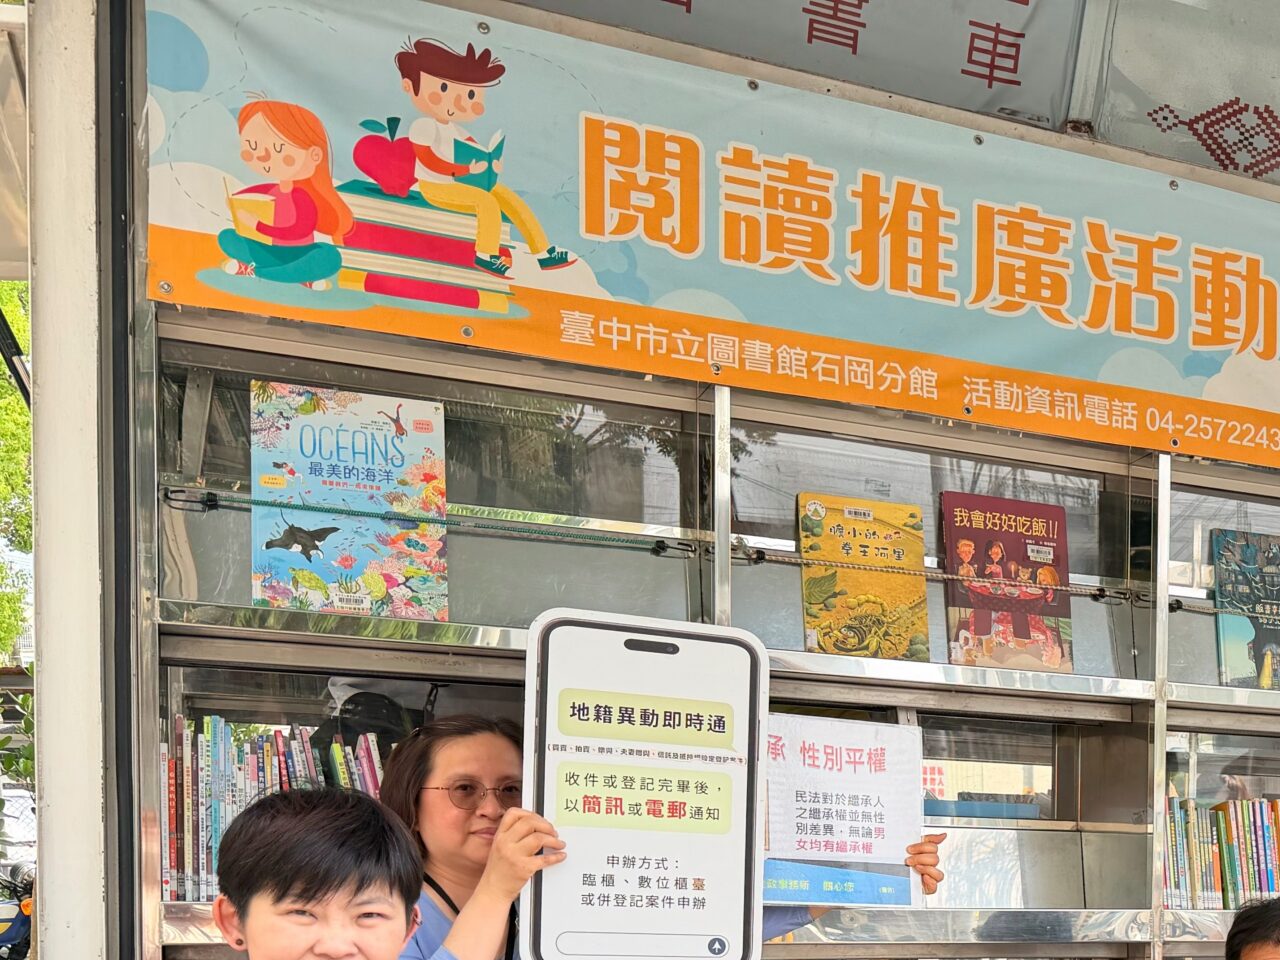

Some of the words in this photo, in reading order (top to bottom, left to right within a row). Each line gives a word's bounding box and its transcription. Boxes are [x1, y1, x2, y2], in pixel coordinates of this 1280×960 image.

[581, 115, 1280, 362] 閱讀推廣活動
[560, 310, 938, 400] 臺中市立圖書館石岡分館
[962, 376, 1138, 434] 活動資訊電話
[308, 461, 396, 485] 最美的海洋
[569, 702, 727, 735] 地籍異動即時通
[800, 740, 887, 774] 性別平權
[564, 771, 722, 796] 收件或登記完畢後，
[564, 794, 721, 822] 以簡訊或電郵通知
[795, 789, 885, 808] 民法對於繼承人
[795, 807, 885, 824] 之繼承權並無性
[796, 838, 873, 854] 女均有繼承權
[606, 855, 680, 871] 申辦方式：
[582, 873, 706, 892] 臨櫃、數位櫃臺
[580, 892, 707, 911] 或併登記案件申辦
